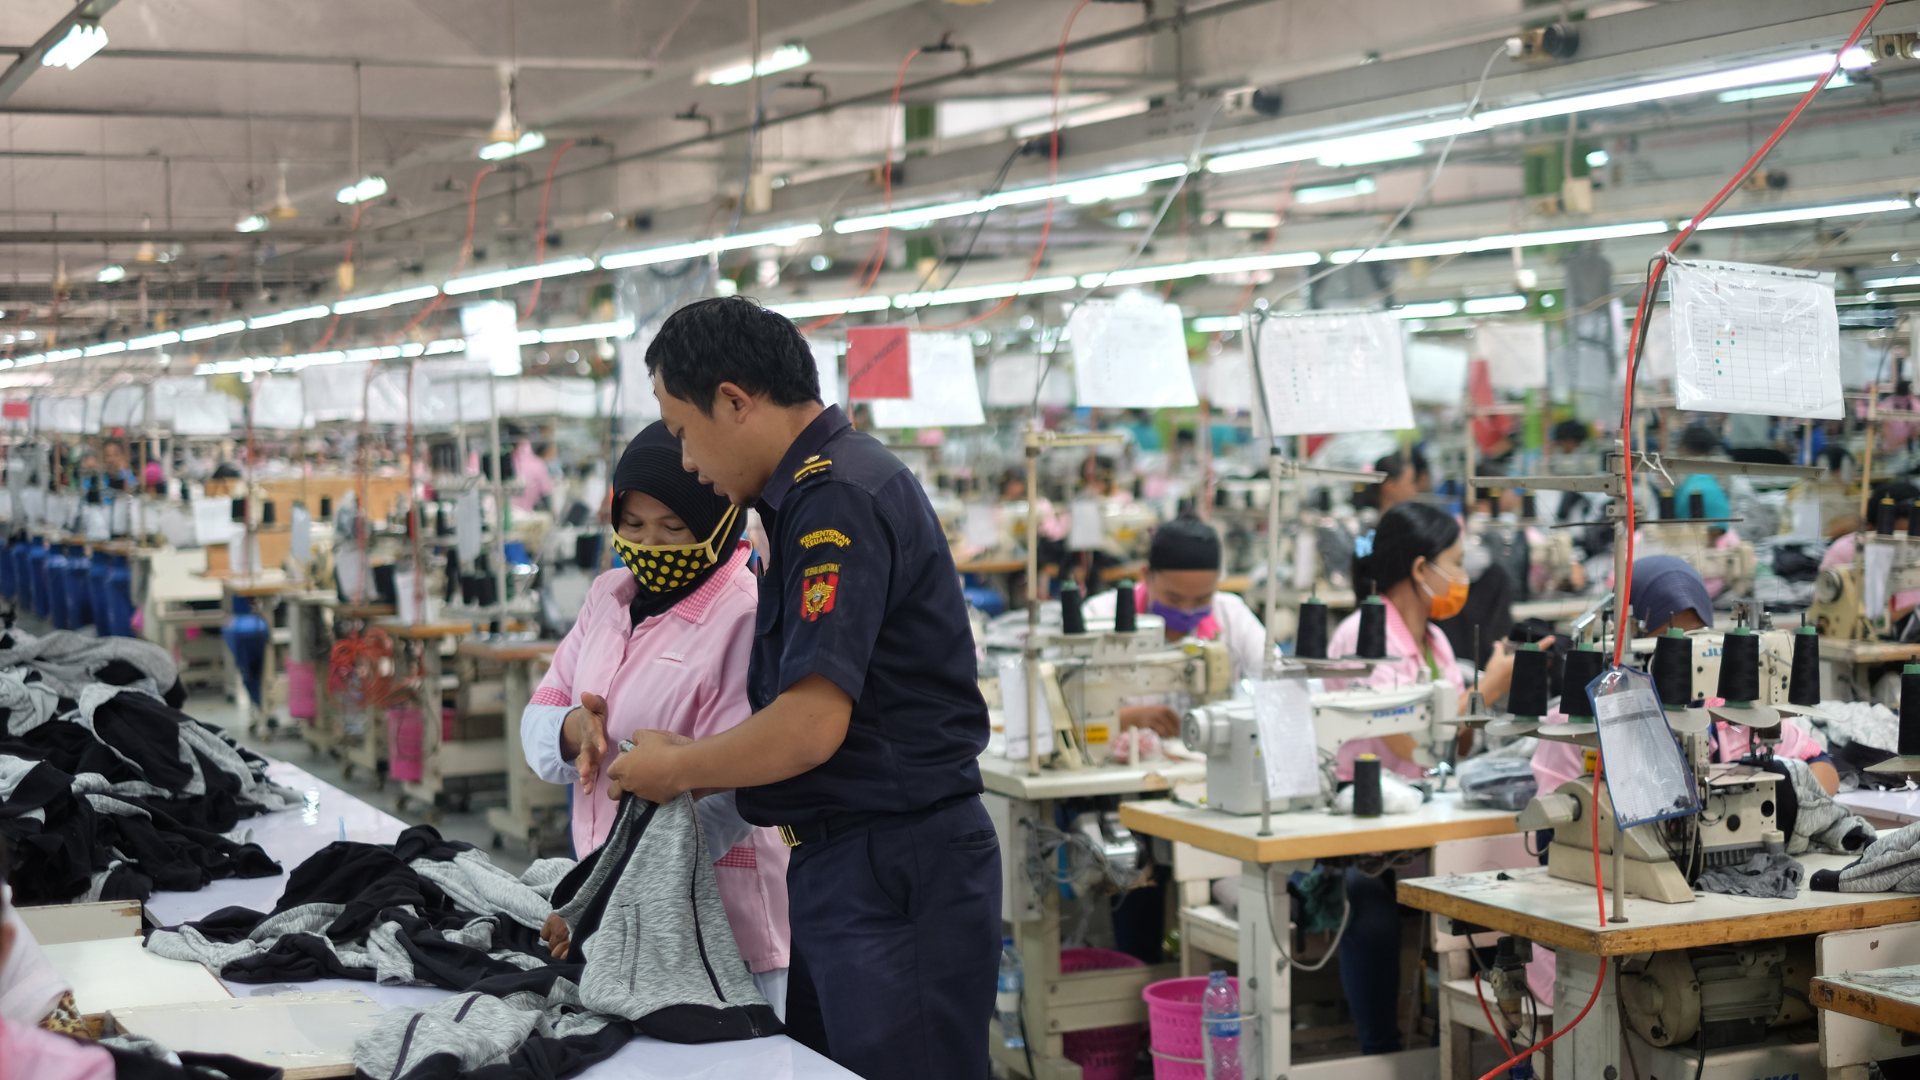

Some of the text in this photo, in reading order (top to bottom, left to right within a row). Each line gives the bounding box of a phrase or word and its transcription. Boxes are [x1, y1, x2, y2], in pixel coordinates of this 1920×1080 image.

[800, 529, 852, 546] KEMENTERIAN
[804, 535, 845, 549] KEUANGAN
[1702, 647, 1722, 657] JU
